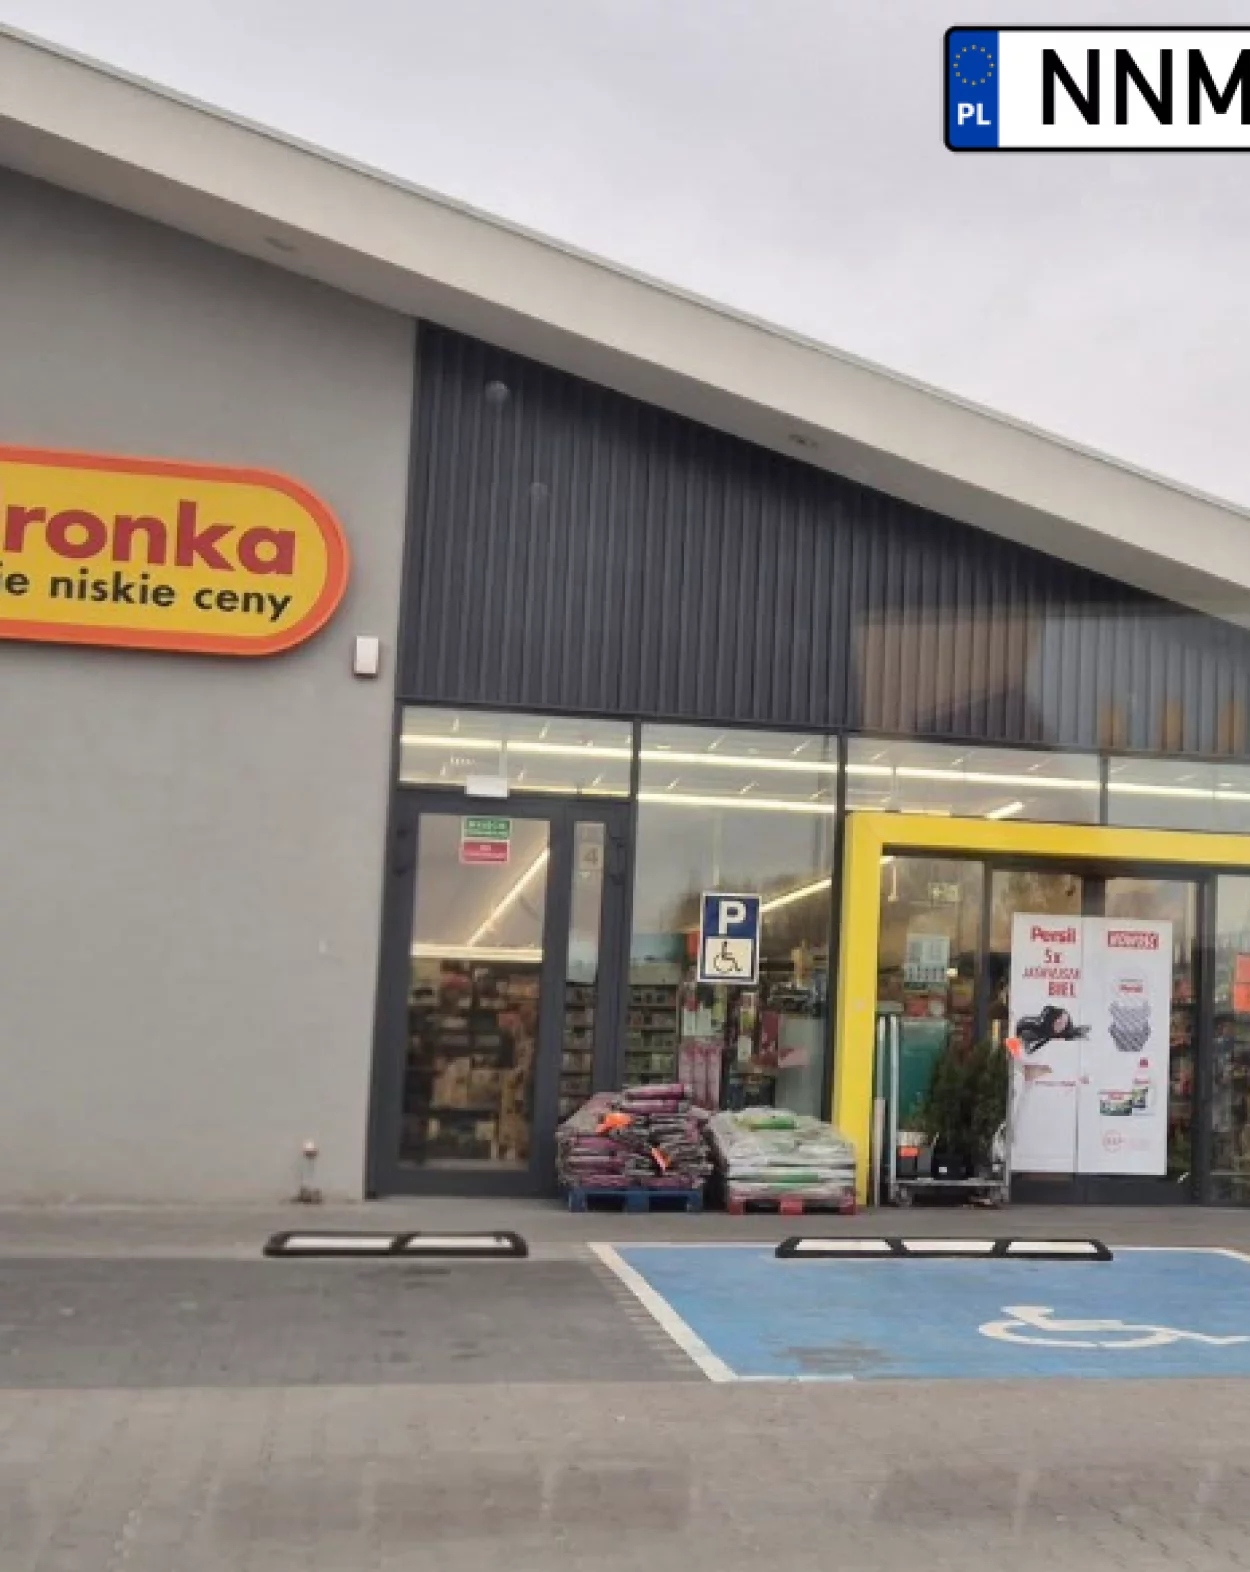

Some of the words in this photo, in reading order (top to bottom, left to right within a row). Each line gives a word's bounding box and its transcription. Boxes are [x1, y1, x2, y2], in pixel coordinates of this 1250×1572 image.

[50, 568, 176, 607] niskie
[193, 587, 292, 623] ceny
[718, 900, 746, 935] P
[1031, 926, 1077, 943] Persil
